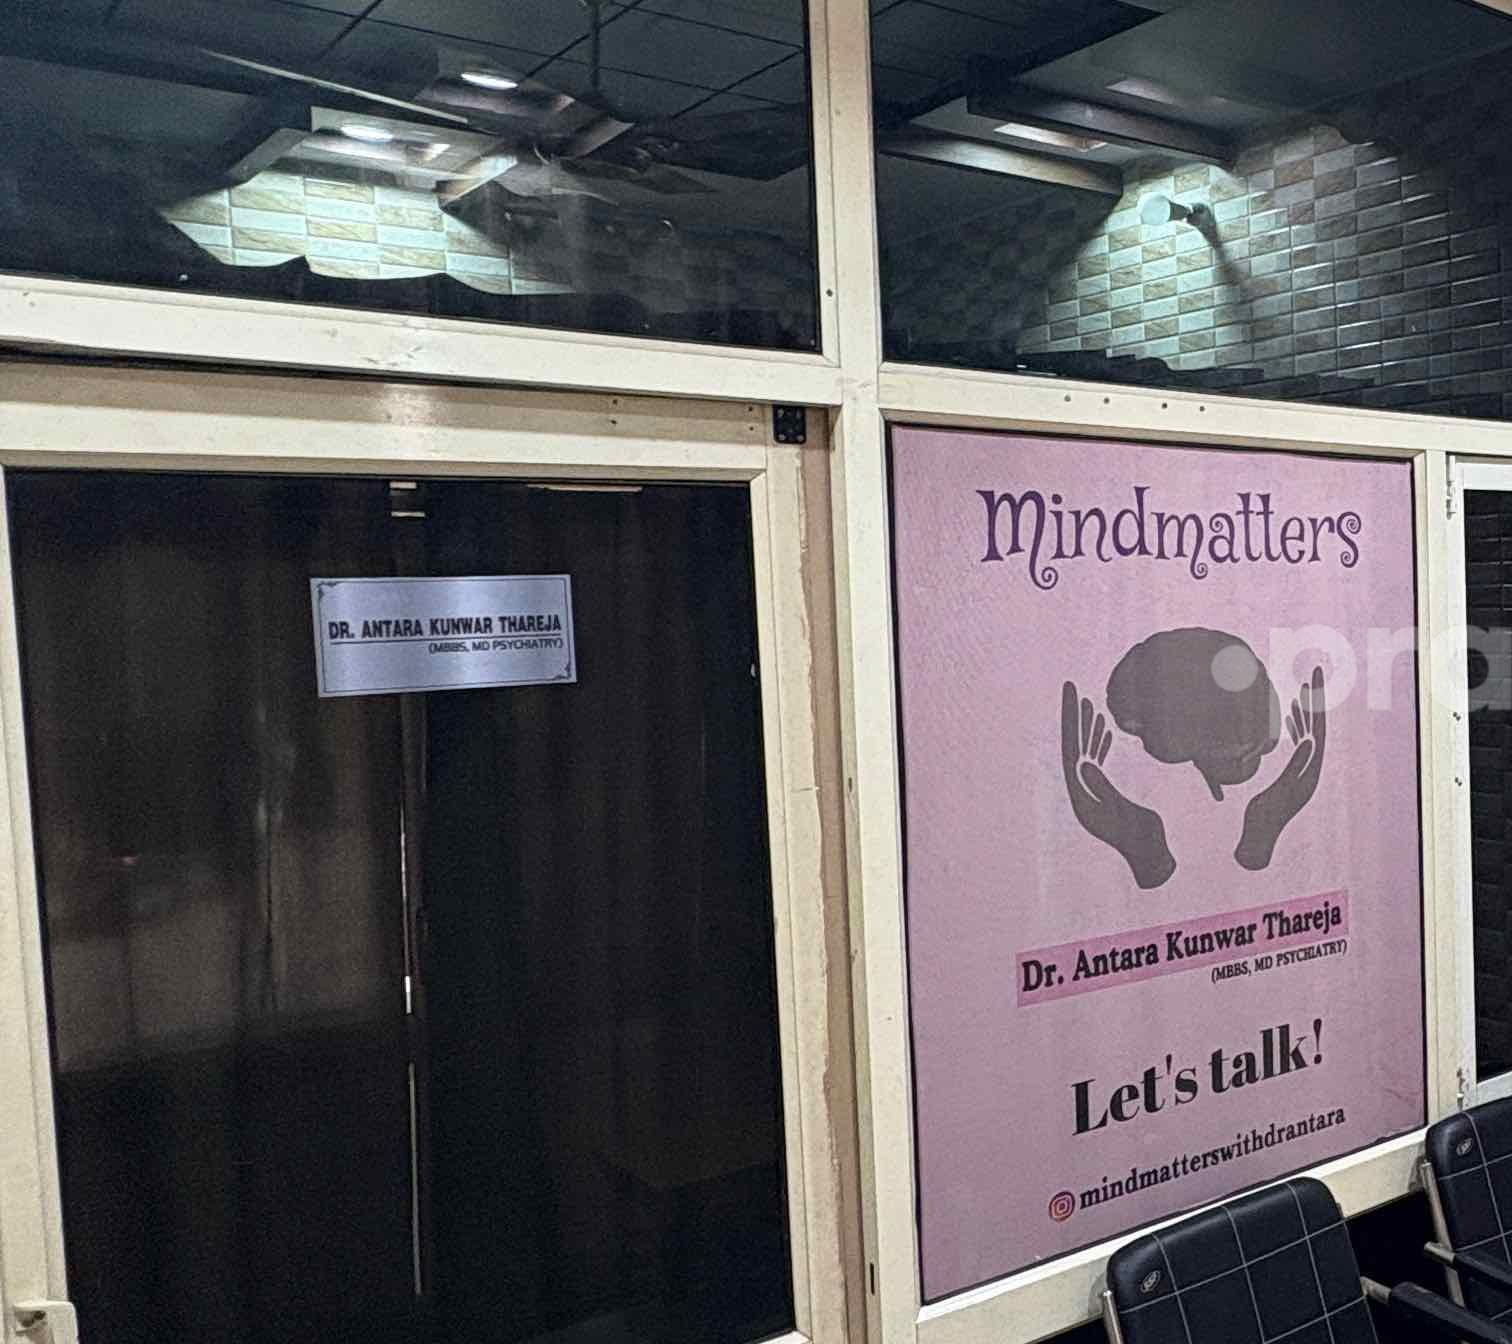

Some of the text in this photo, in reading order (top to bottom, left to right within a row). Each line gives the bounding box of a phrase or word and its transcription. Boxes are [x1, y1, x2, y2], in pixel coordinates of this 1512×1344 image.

[975, 486, 1362, 590] Mindmatters
[328, 614, 562, 640] DR. ANTARA KUNWAR THAREJA
[429, 638, 563, 655] (MBBS, MD PSYCHIATRY)
[1021, 901, 1342, 993] Dr. Antara Kunwar Thareja
[1211, 938, 1348, 984] (MBBS, MD PSYCHIATRY)
[1071, 1018, 1323, 1136] Let's talk!
[1079, 1107, 1347, 1210] mindmatterswithdrantara
